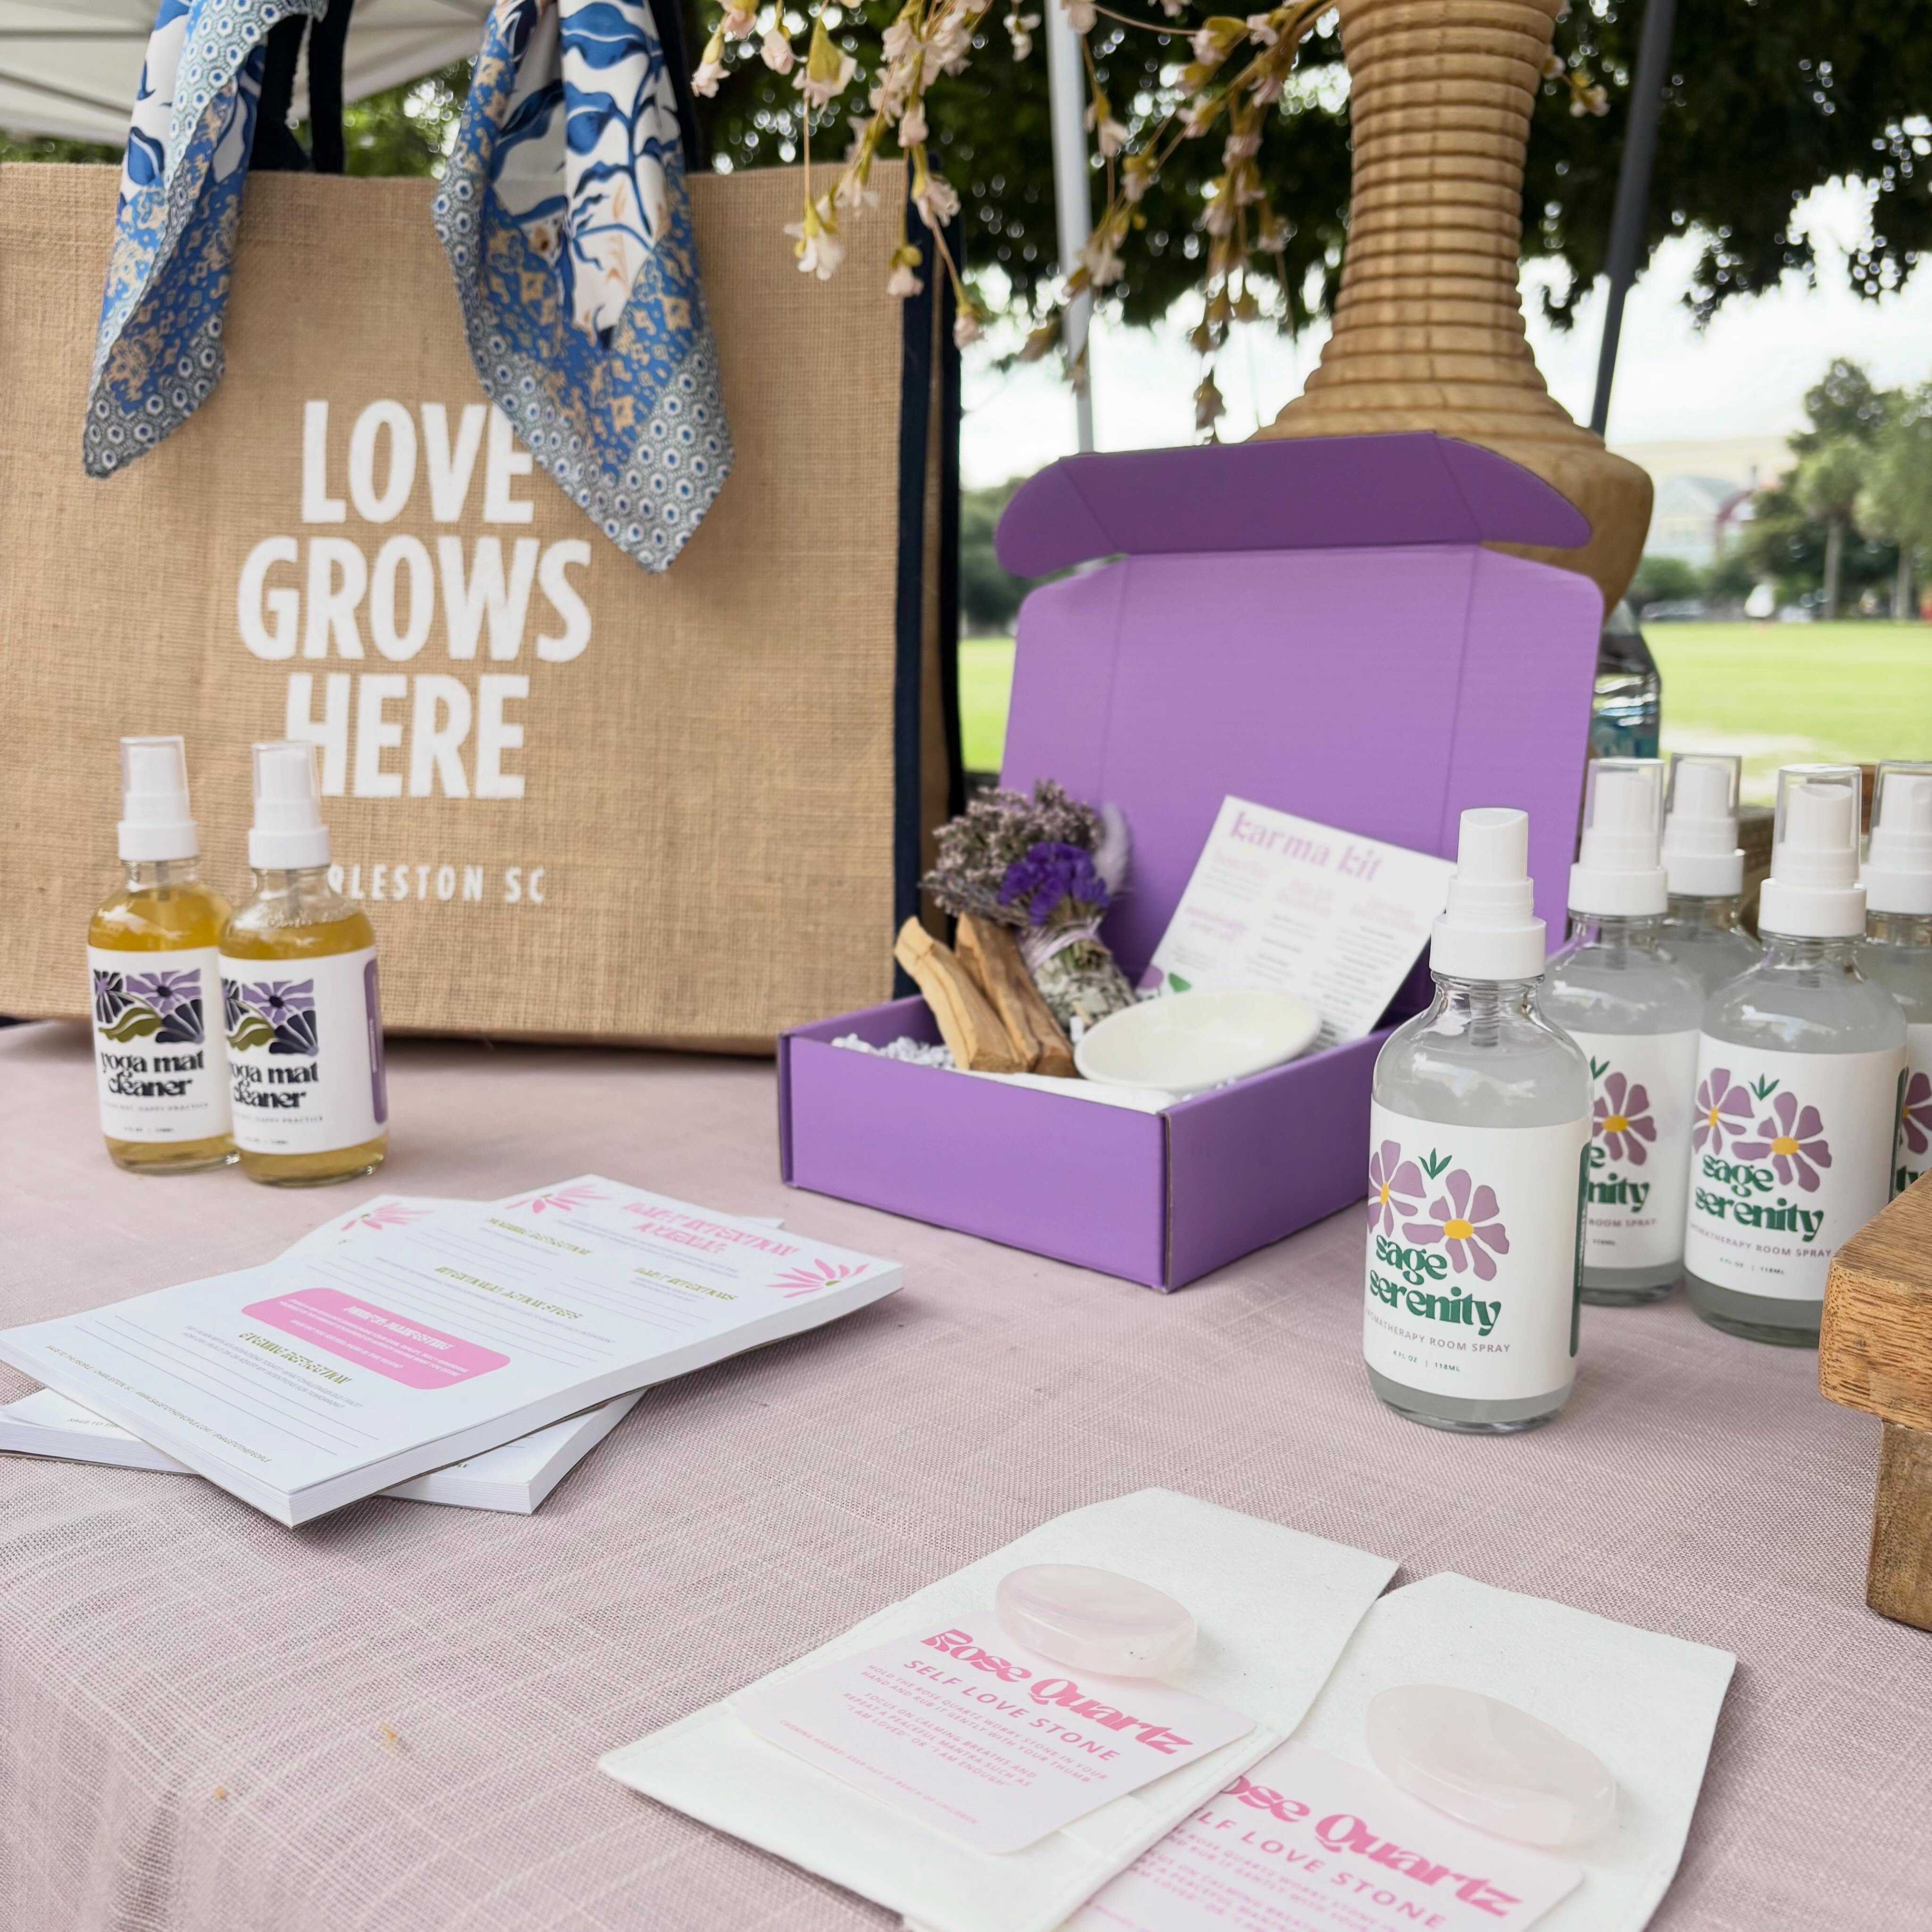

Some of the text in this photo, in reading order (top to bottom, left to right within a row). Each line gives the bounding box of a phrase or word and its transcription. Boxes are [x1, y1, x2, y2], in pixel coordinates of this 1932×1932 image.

[301, 399, 533, 523] LOVE
[237, 535, 591, 661] GROWS
[285, 673, 529, 798] HERE
[1229, 810, 1331, 867] karma
[1337, 845, 1383, 881] kit
[327, 863, 545, 903] RLESTON SC
[101, 1050, 204, 1078] yoga mat
[109, 1071, 192, 1096] cleaner
[230, 1062, 318, 1087] oga mat
[1703, 1154, 1774, 1197] sage
[1695, 1187, 1824, 1242] serenity
[1376, 1235, 1448, 1285] sage
[1756, 1245, 1791, 1256] ROOM
[1796, 1249, 1832, 1258] SPRAY
[1370, 1270, 1501, 1336] serenity
[239, 1333, 288, 1354] EVENING
[280, 1352, 352, 1383] REFLECTION
[1408, 1355, 1418, 1363] OZ
[1435, 1362, 1460, 1372] 118ML
[1430, 1338, 1466, 1351] ROOM
[1472, 1343, 1510, 1353] SPRAY
[867, 1665, 894, 1678] HOLD
[896, 1677, 915, 1687] THE
[915, 1687, 941, 1700] ROSE
[941, 1700, 983, 1719] QUARTZ
[983, 1719, 1021, 1737] WORRY
[1022, 1738, 1058, 1756] STONE
[1075, 1763, 1108, 1780] YOUR
[904, 1660, 1119, 1760] SELF LOVE STONE
[921, 1629, 1192, 1754] Rose Quartz
[843, 1693, 879, 1710] REPEAT
[888, 1715, 936, 1740] PEACEFUL
[938, 1740, 982, 1763] MANTRA
[984, 1763, 1015, 1778] SUCH
[861, 1672, 889, 1685] HAND
[890, 1685, 912, 1696] AND
[913, 1696, 934, 1706] RUB
[947, 1713, 987, 1731] GENTLY
[988, 1731, 1016, 1746] WITH
[1018, 1746, 1048, 1761] YOUR
[1050, 1761, 1090, 1781] THUMB
[864, 1693, 898, 1709] FOCUS
[915, 1718, 962, 1741] CALMING
[962, 1741, 1009, 1765] BREATHS
[1011, 1765, 1036, 1777] AND
[1198, 1811, 1237, 1831] LF
[1241, 1831, 1325, 1873] LOVE
[1331, 1871, 1447, 1929] STONE
[1224, 1776, 1523, 1917] ose Quartz
